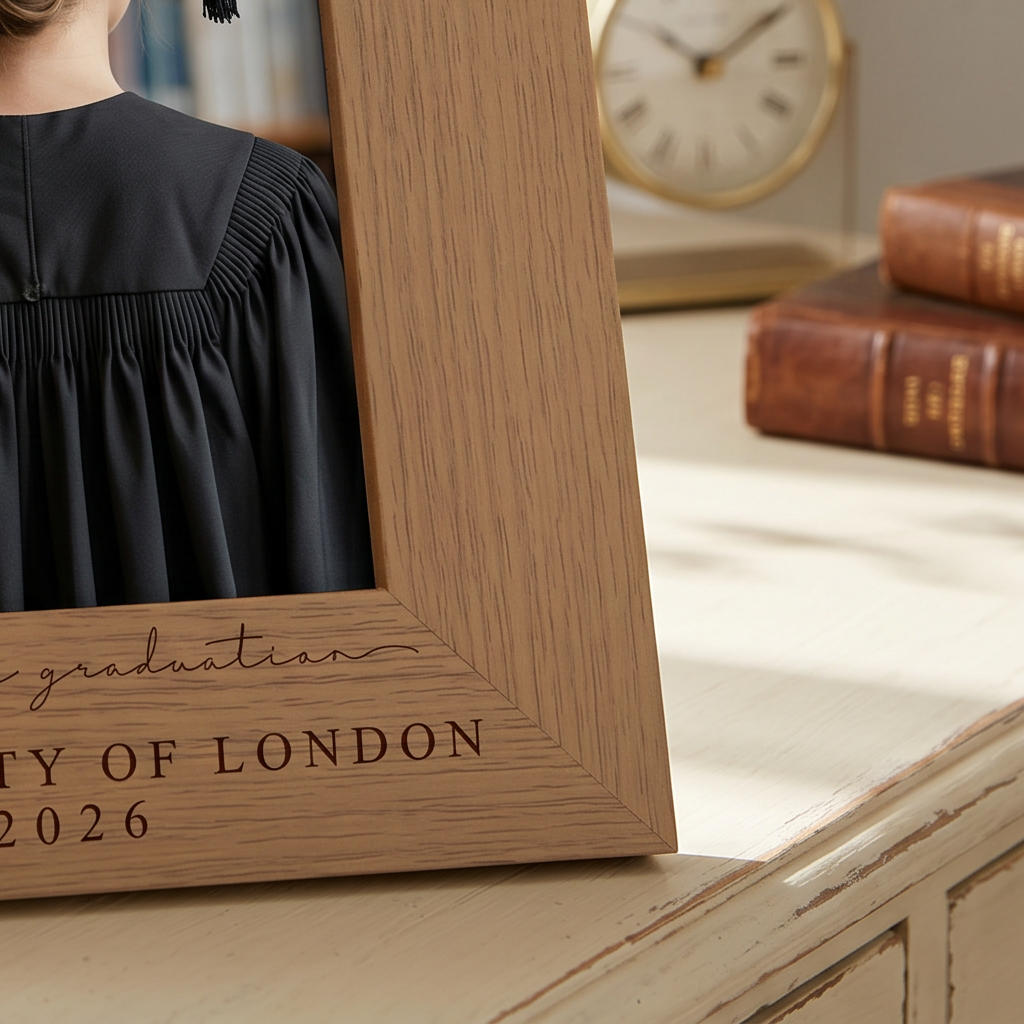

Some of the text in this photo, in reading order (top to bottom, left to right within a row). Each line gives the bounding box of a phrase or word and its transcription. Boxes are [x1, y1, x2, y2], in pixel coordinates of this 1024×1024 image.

[30, 623, 420, 711] graduation
[101, 740, 178, 781] OF
[213, 719, 484, 775] LONDON
